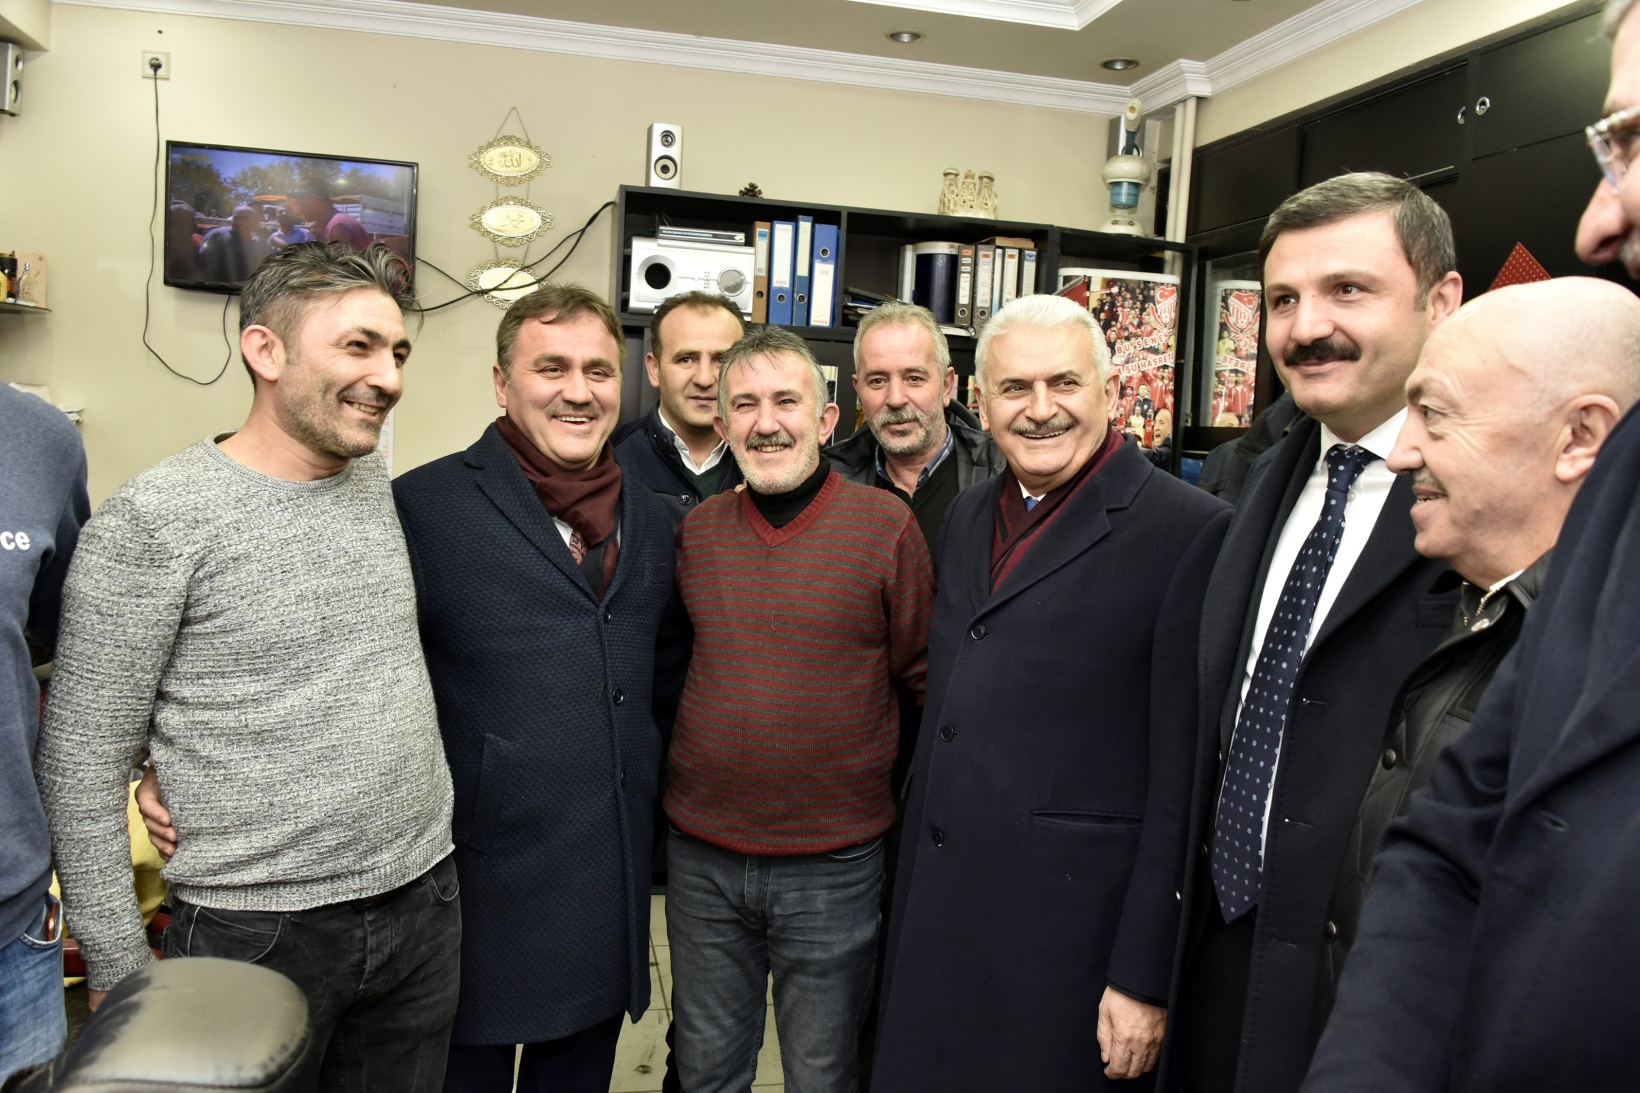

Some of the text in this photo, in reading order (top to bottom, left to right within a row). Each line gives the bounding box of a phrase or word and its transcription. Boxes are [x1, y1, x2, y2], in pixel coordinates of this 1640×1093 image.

[1116, 333, 1164, 355] BU SENE
[0, 531, 31, 551] ce
